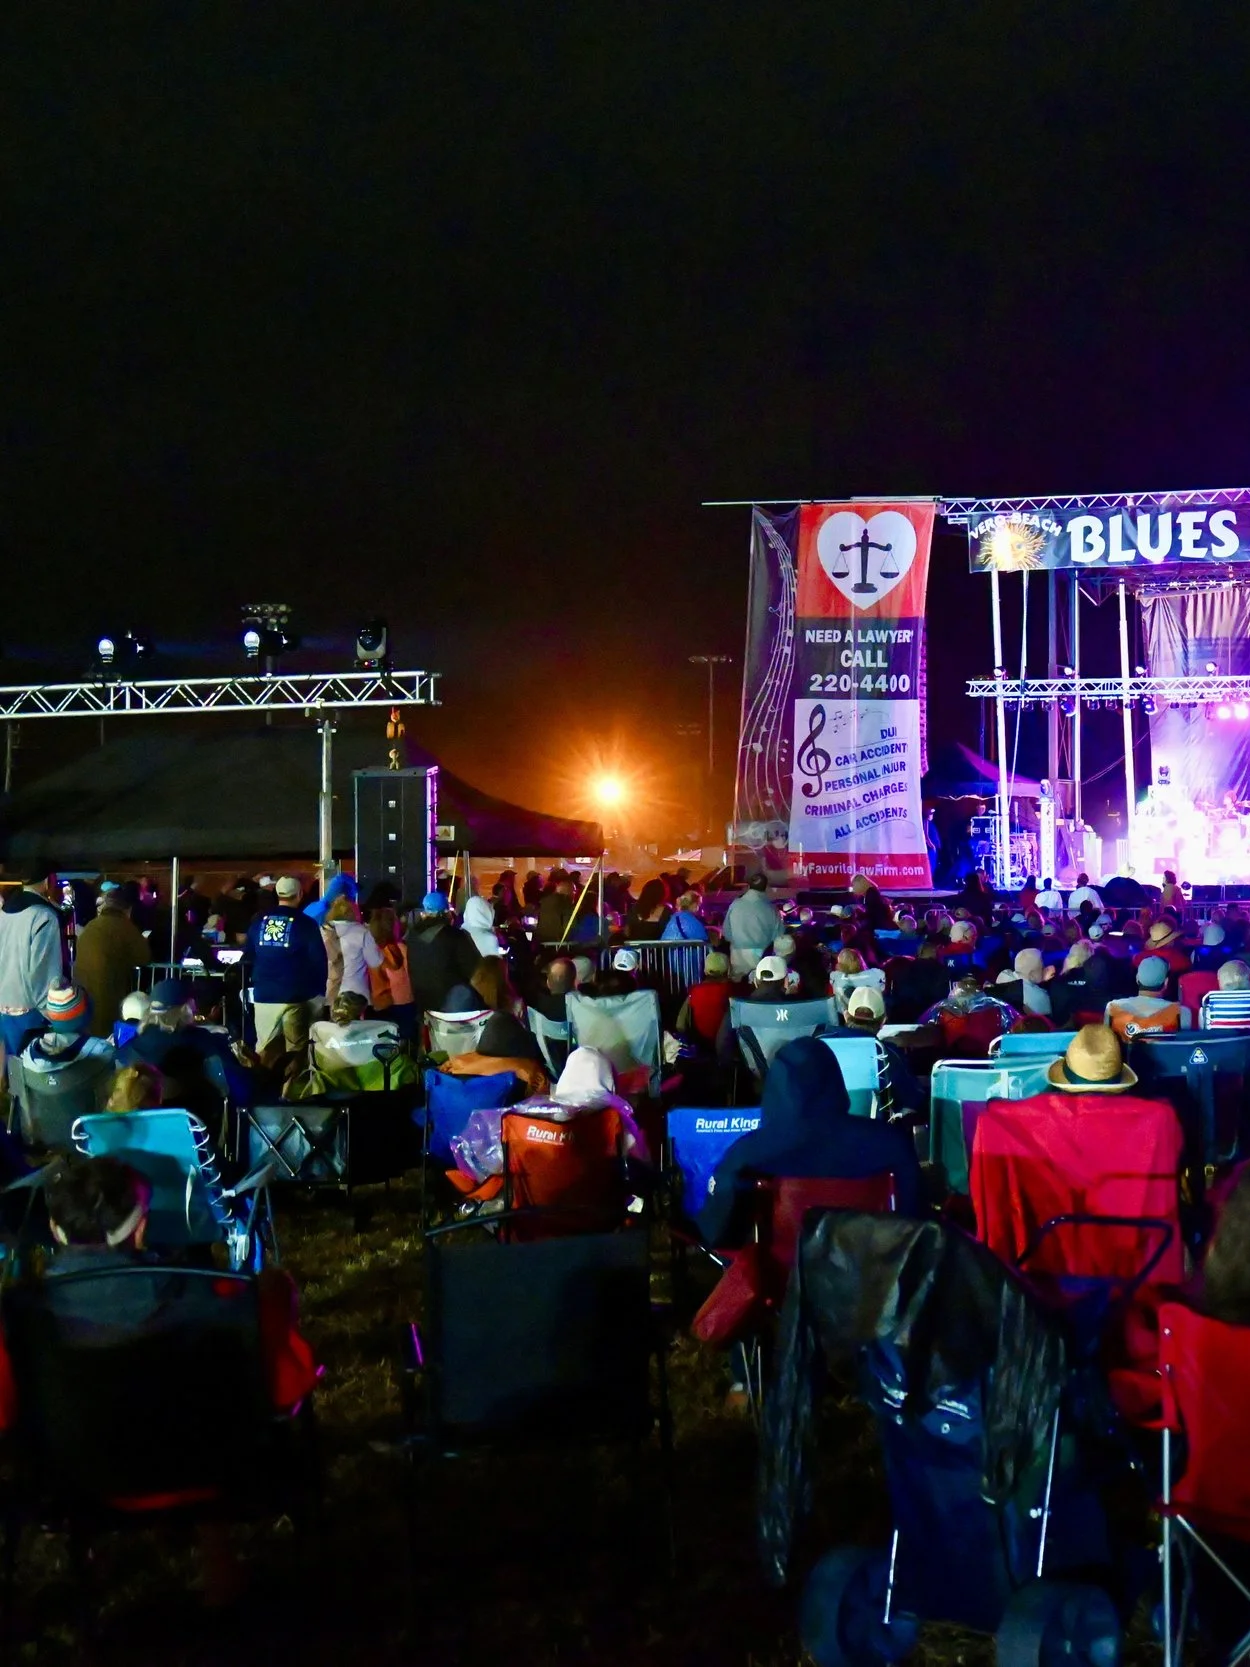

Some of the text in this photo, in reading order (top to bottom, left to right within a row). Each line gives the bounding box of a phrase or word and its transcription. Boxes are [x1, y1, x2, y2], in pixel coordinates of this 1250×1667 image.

[970, 512, 1062, 539] VERO BEACH
[1066, 510, 1240, 563] BLUES
[805, 629, 914, 643] NEED A LAWYER
[840, 649, 888, 668] CALL
[809, 674, 911, 692] 220-4400
[880, 727, 897, 740] DUI
[860, 743, 908, 762] ACCIDENT
[825, 761, 906, 792] PERSONAL INJUR
[805, 798, 860, 816] CRIMINAL
[856, 807, 908, 829] ACCIDENTS
[793, 862, 924, 876] MyFavoriteLawFirm.com
[695, 1117, 761, 1130] Rural King
[526, 1125, 557, 1141] Rural
